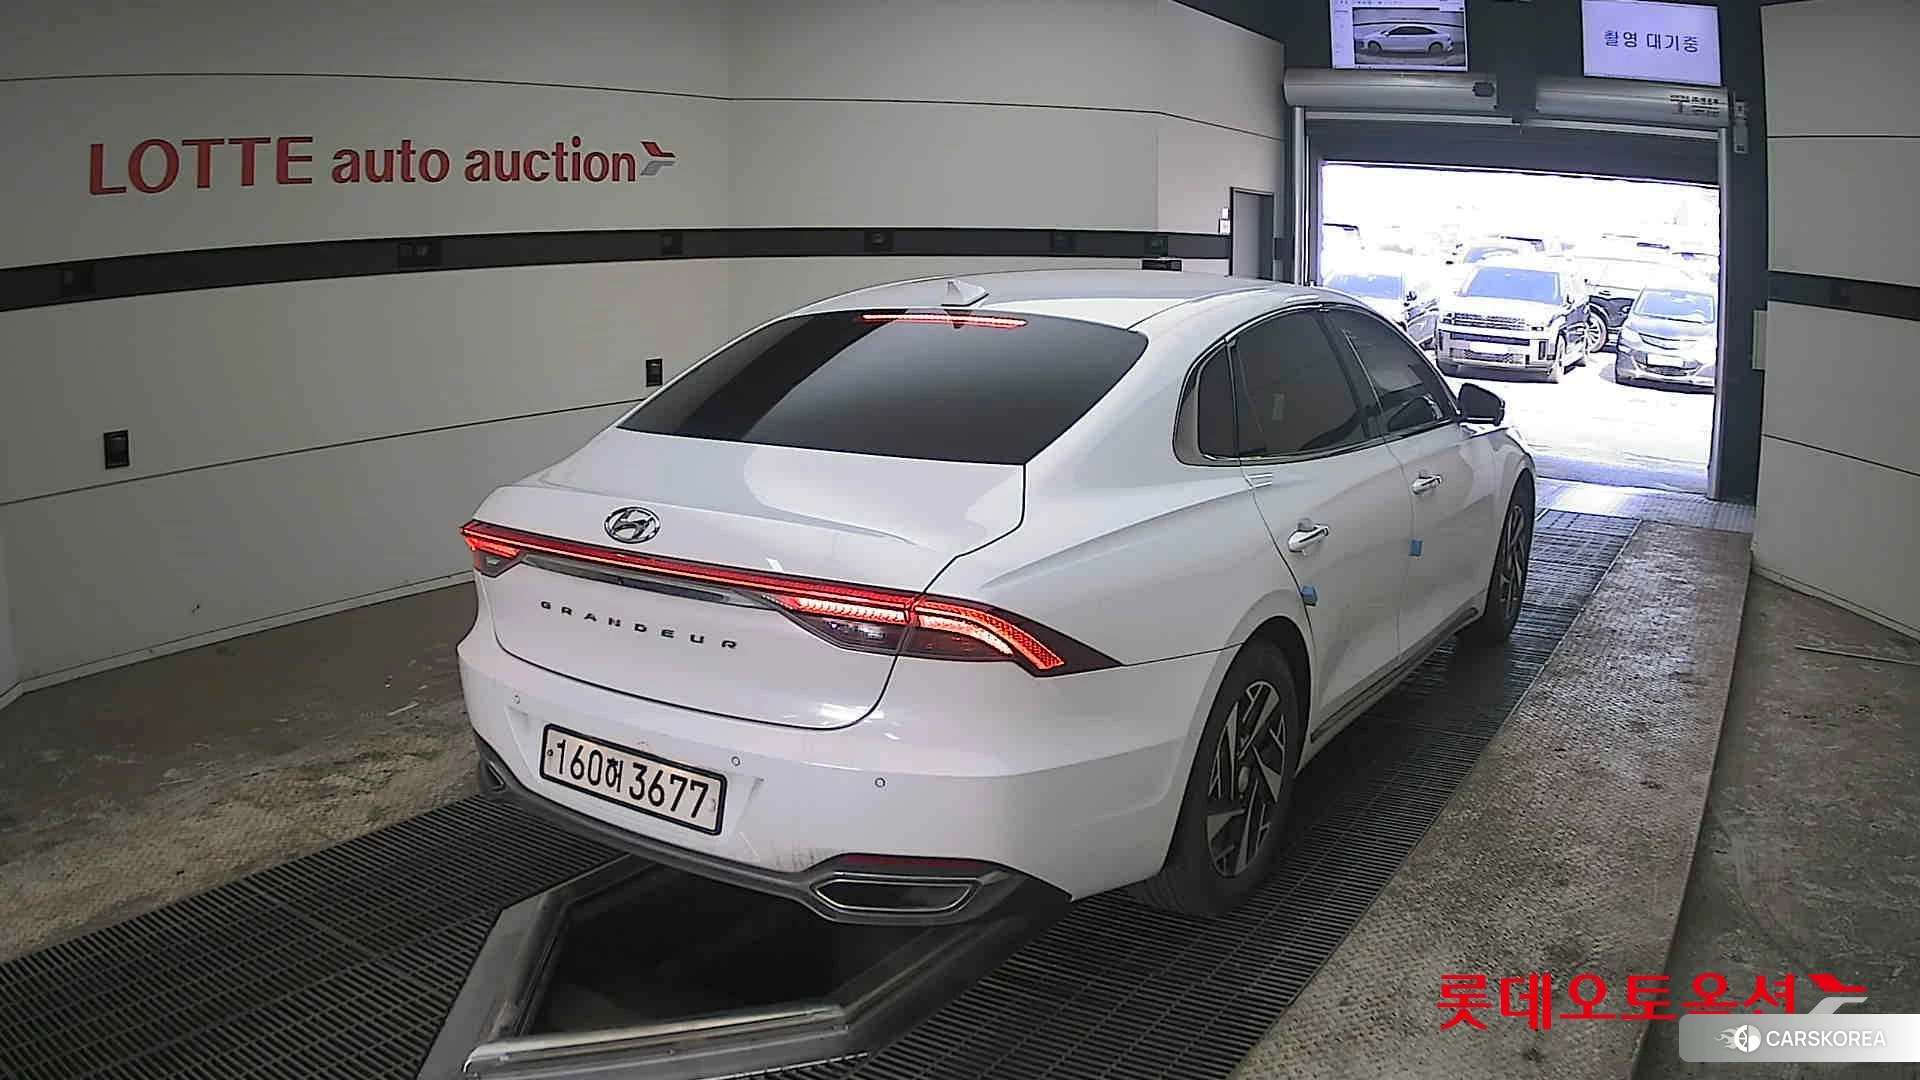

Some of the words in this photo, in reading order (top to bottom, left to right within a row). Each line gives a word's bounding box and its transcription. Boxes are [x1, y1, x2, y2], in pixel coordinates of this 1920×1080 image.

[1646, 33, 1698, 53] 대기중
[89, 136, 313, 196] LOTTE
[331, 139, 450, 184] auto
[463, 135, 638, 183] auction
[540, 600, 737, 649] GRANDEUR
[628, 761, 709, 818] 3677
